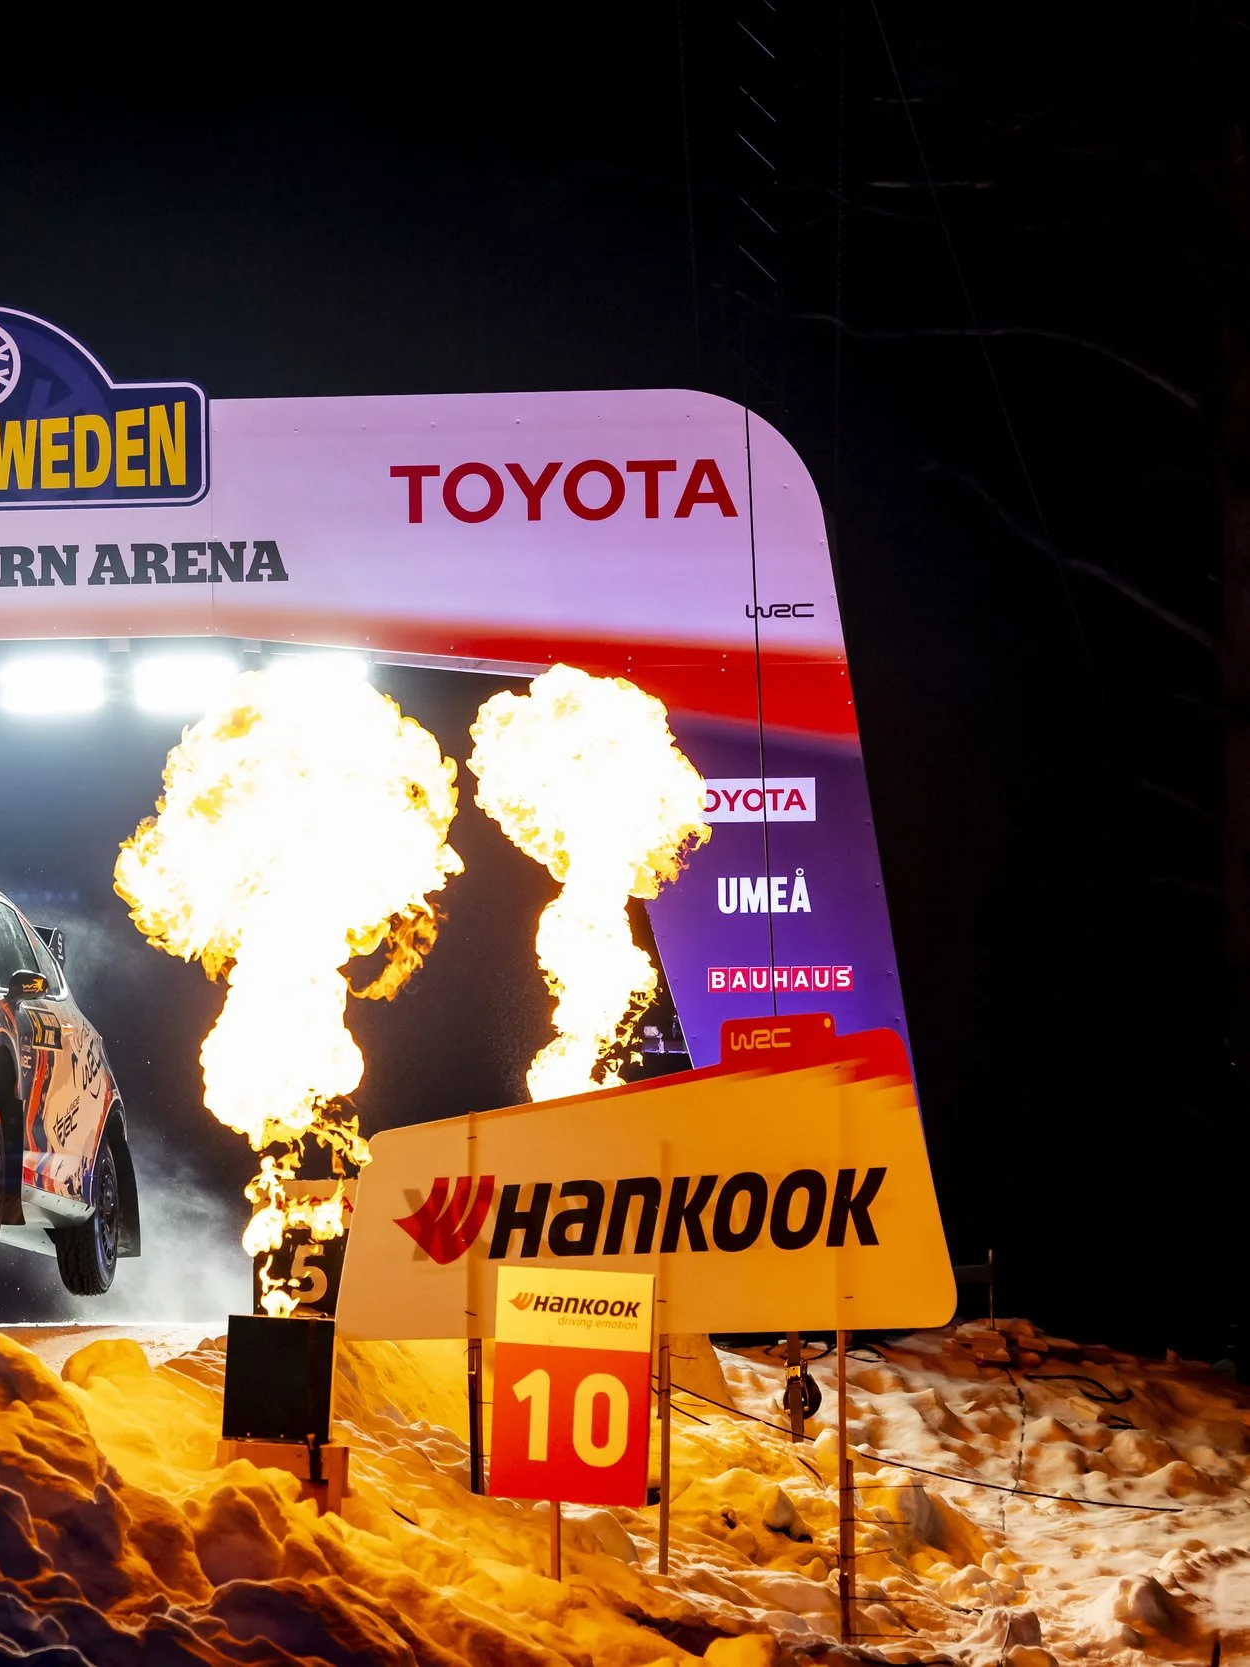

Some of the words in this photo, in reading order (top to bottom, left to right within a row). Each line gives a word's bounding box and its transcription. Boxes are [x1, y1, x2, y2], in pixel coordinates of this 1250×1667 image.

[389, 458, 739, 524] TOYOTA
[87, 540, 289, 586] ARENA
[745, 603, 815, 619] WRC
[703, 788, 807, 813] OYOTA
[717, 867, 812, 915] UMEÅ
[710, 969, 852, 989] BAUHAUS
[730, 1027, 792, 1051] WRC
[557, 1316, 593, 1330] driving
[595, 1319, 639, 1331] emotion
[512, 1368, 628, 1467] 10
